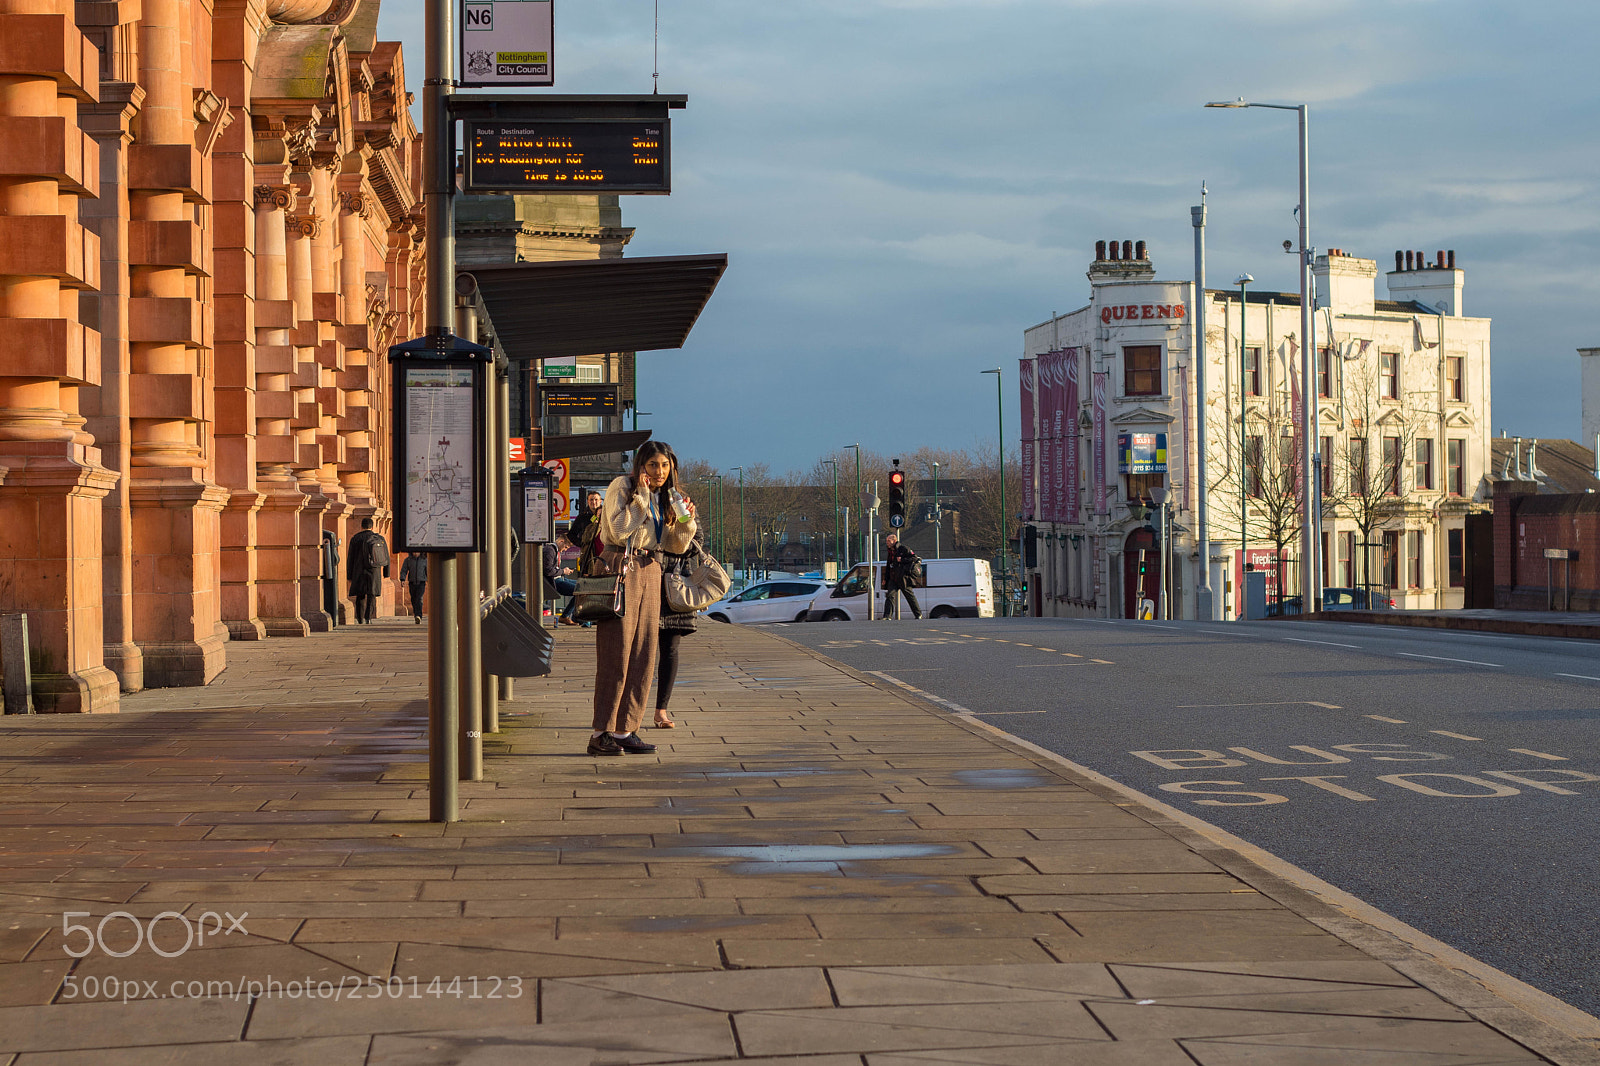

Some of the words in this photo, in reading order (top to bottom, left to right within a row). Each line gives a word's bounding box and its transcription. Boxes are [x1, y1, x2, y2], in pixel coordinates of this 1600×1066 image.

[466, 9, 492, 25] N6
[498, 52, 545, 63] Nottingham
[498, 66, 516, 75] City
[516, 66, 546, 74] Council
[1101, 304, 1186, 324] QUEENS
[1054, 410, 1064, 444] Parking
[1066, 418, 1076, 468] Showroom
[1024, 444, 1032, 476] Heating
[1042, 463, 1049, 473] of
[1054, 446, 1063, 489] Customer
[1024, 478, 1032, 508] Central
[1055, 491, 1063, 510] Free
[1066, 469, 1076, 510] Fireplace
[1252, 552, 1278, 567] fireplac
[1127, 744, 1456, 770] BUS
[1158, 770, 1599, 806] STOP
